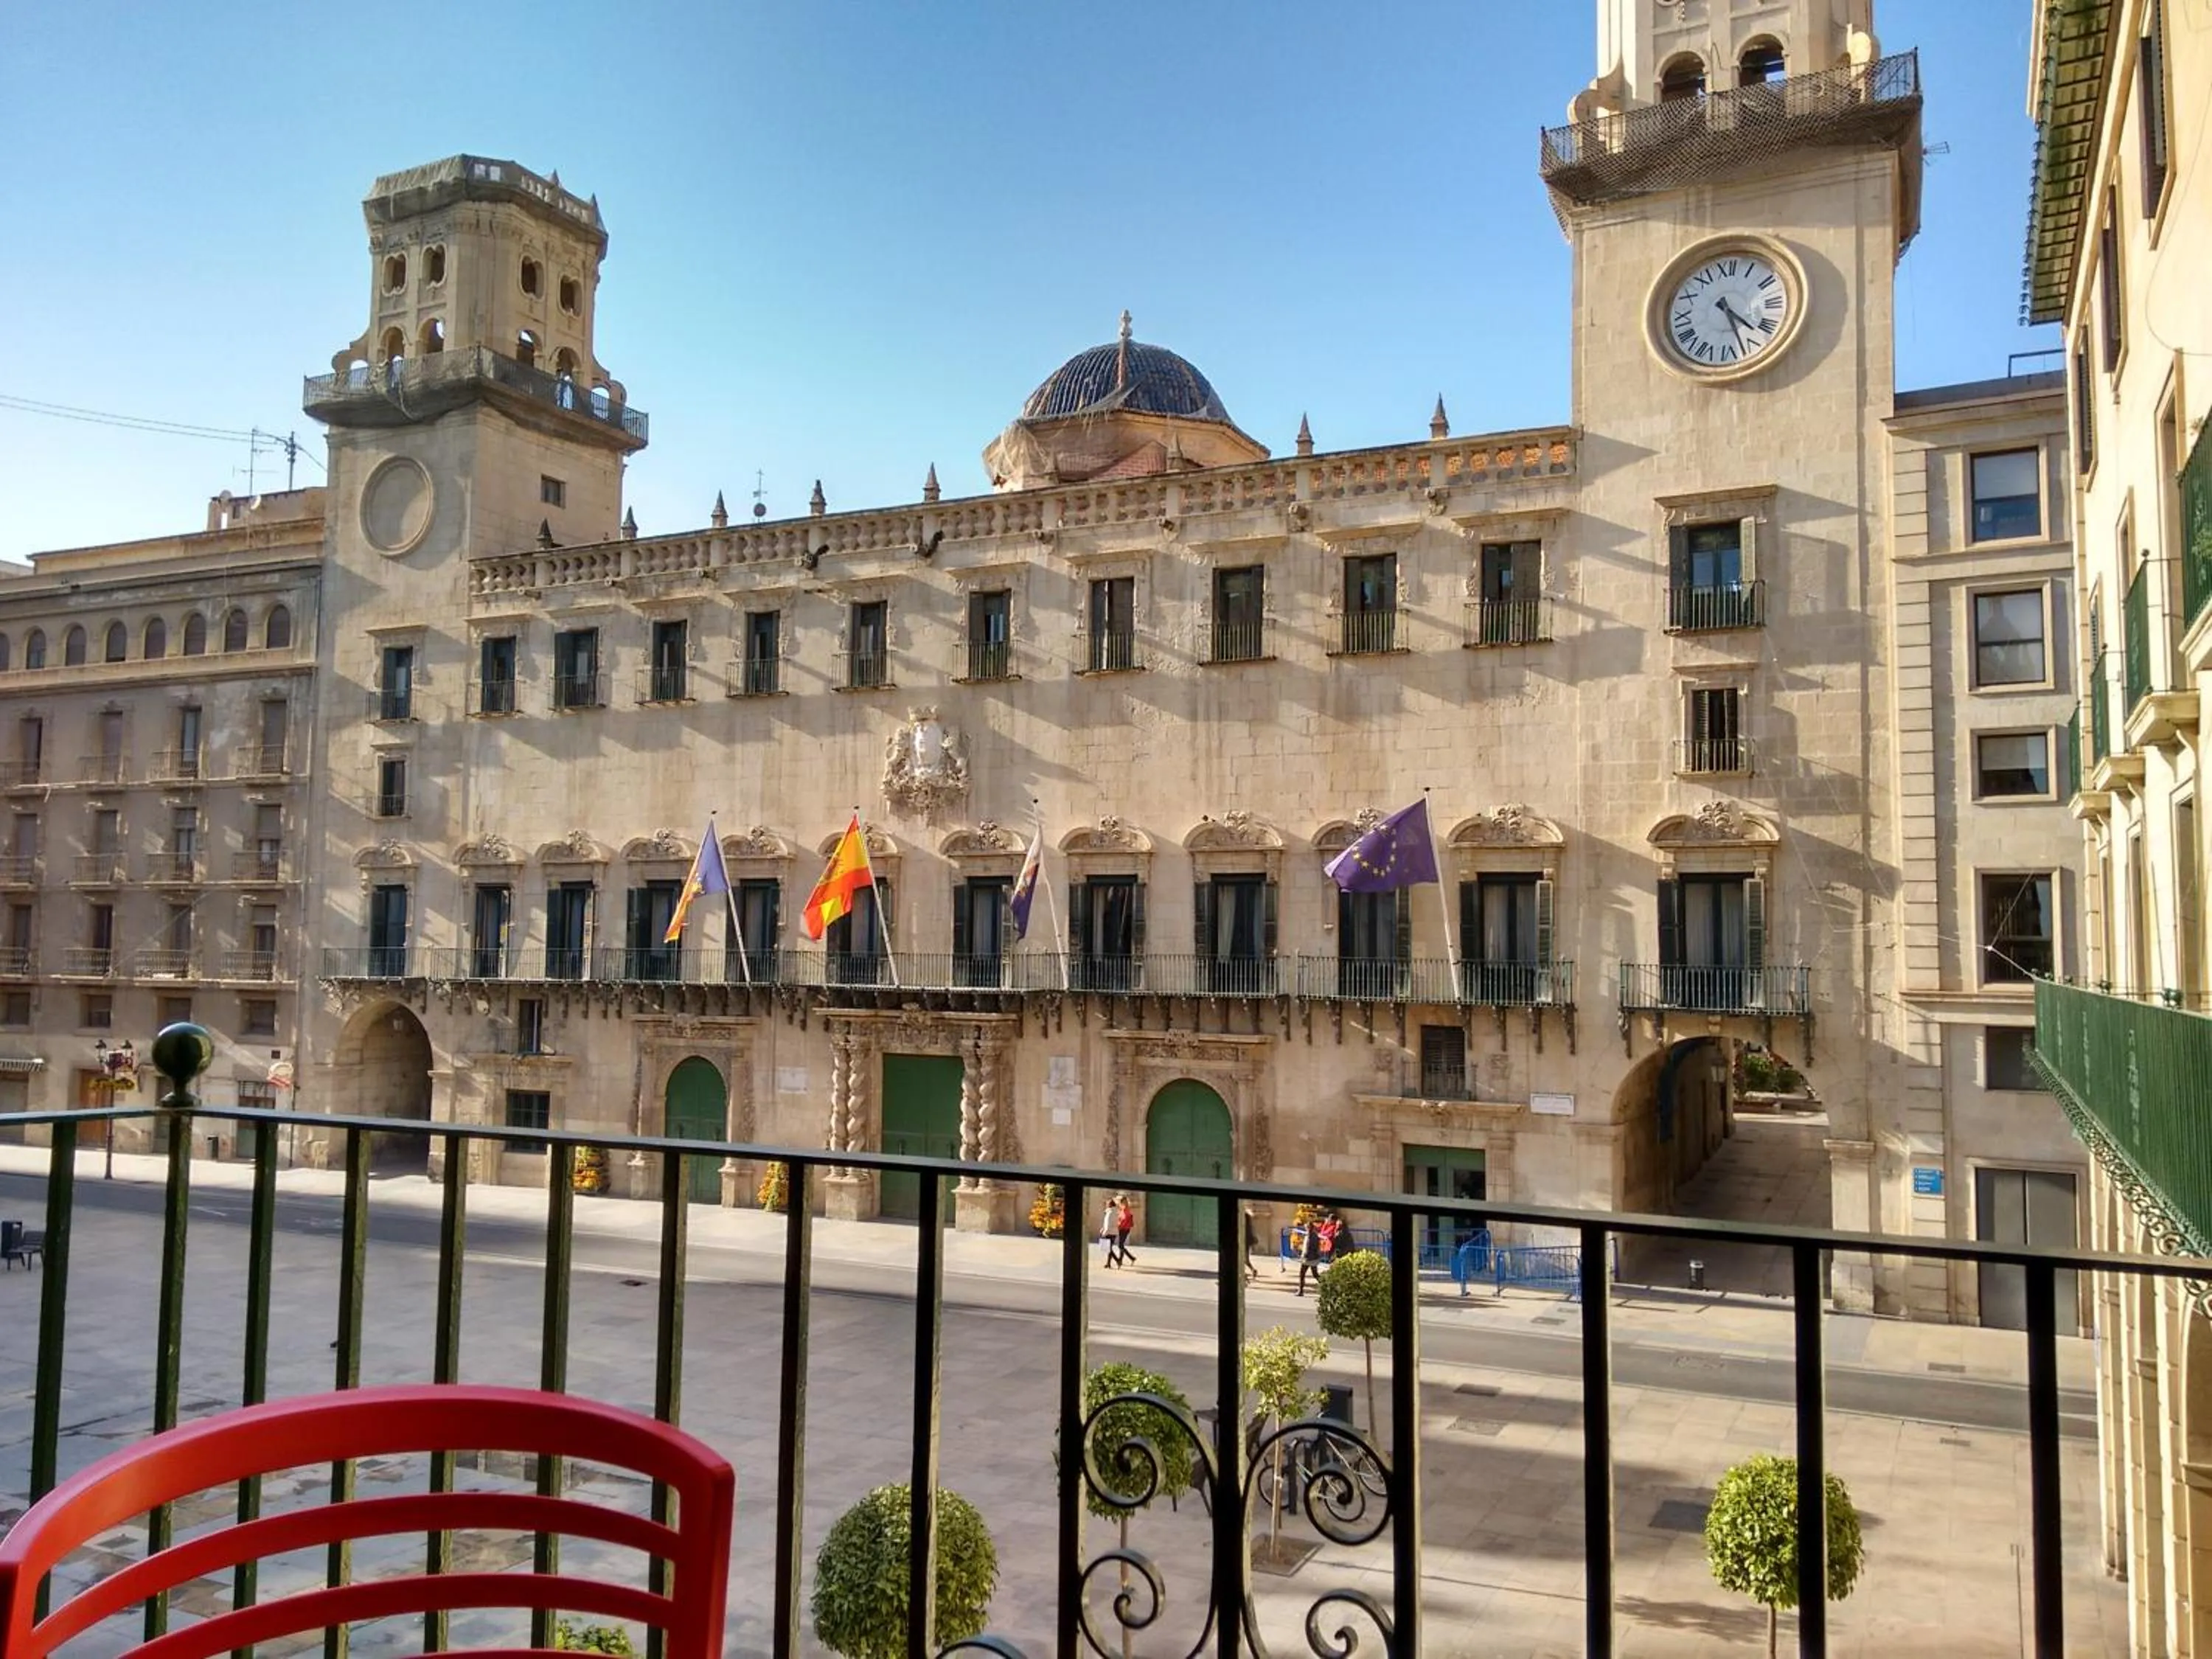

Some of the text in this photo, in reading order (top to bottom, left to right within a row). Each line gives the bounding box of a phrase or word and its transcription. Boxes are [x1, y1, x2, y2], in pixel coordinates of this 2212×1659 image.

[1693, 268, 1713, 289] XI
[1717, 260, 1736, 280] XII
[1745, 262, 1755, 279] I
[1758, 274, 1776, 290] II
[1678, 288, 1698, 306] X
[1764, 296, 1783, 308] III
[1674, 310, 1691, 328] IX
[1758, 318, 1778, 334] IIII
[1677, 328, 1699, 352] VIII
[1747, 338, 1761, 354] V
[1694, 341, 1713, 361] VII
[1721, 344, 1737, 361] VI
